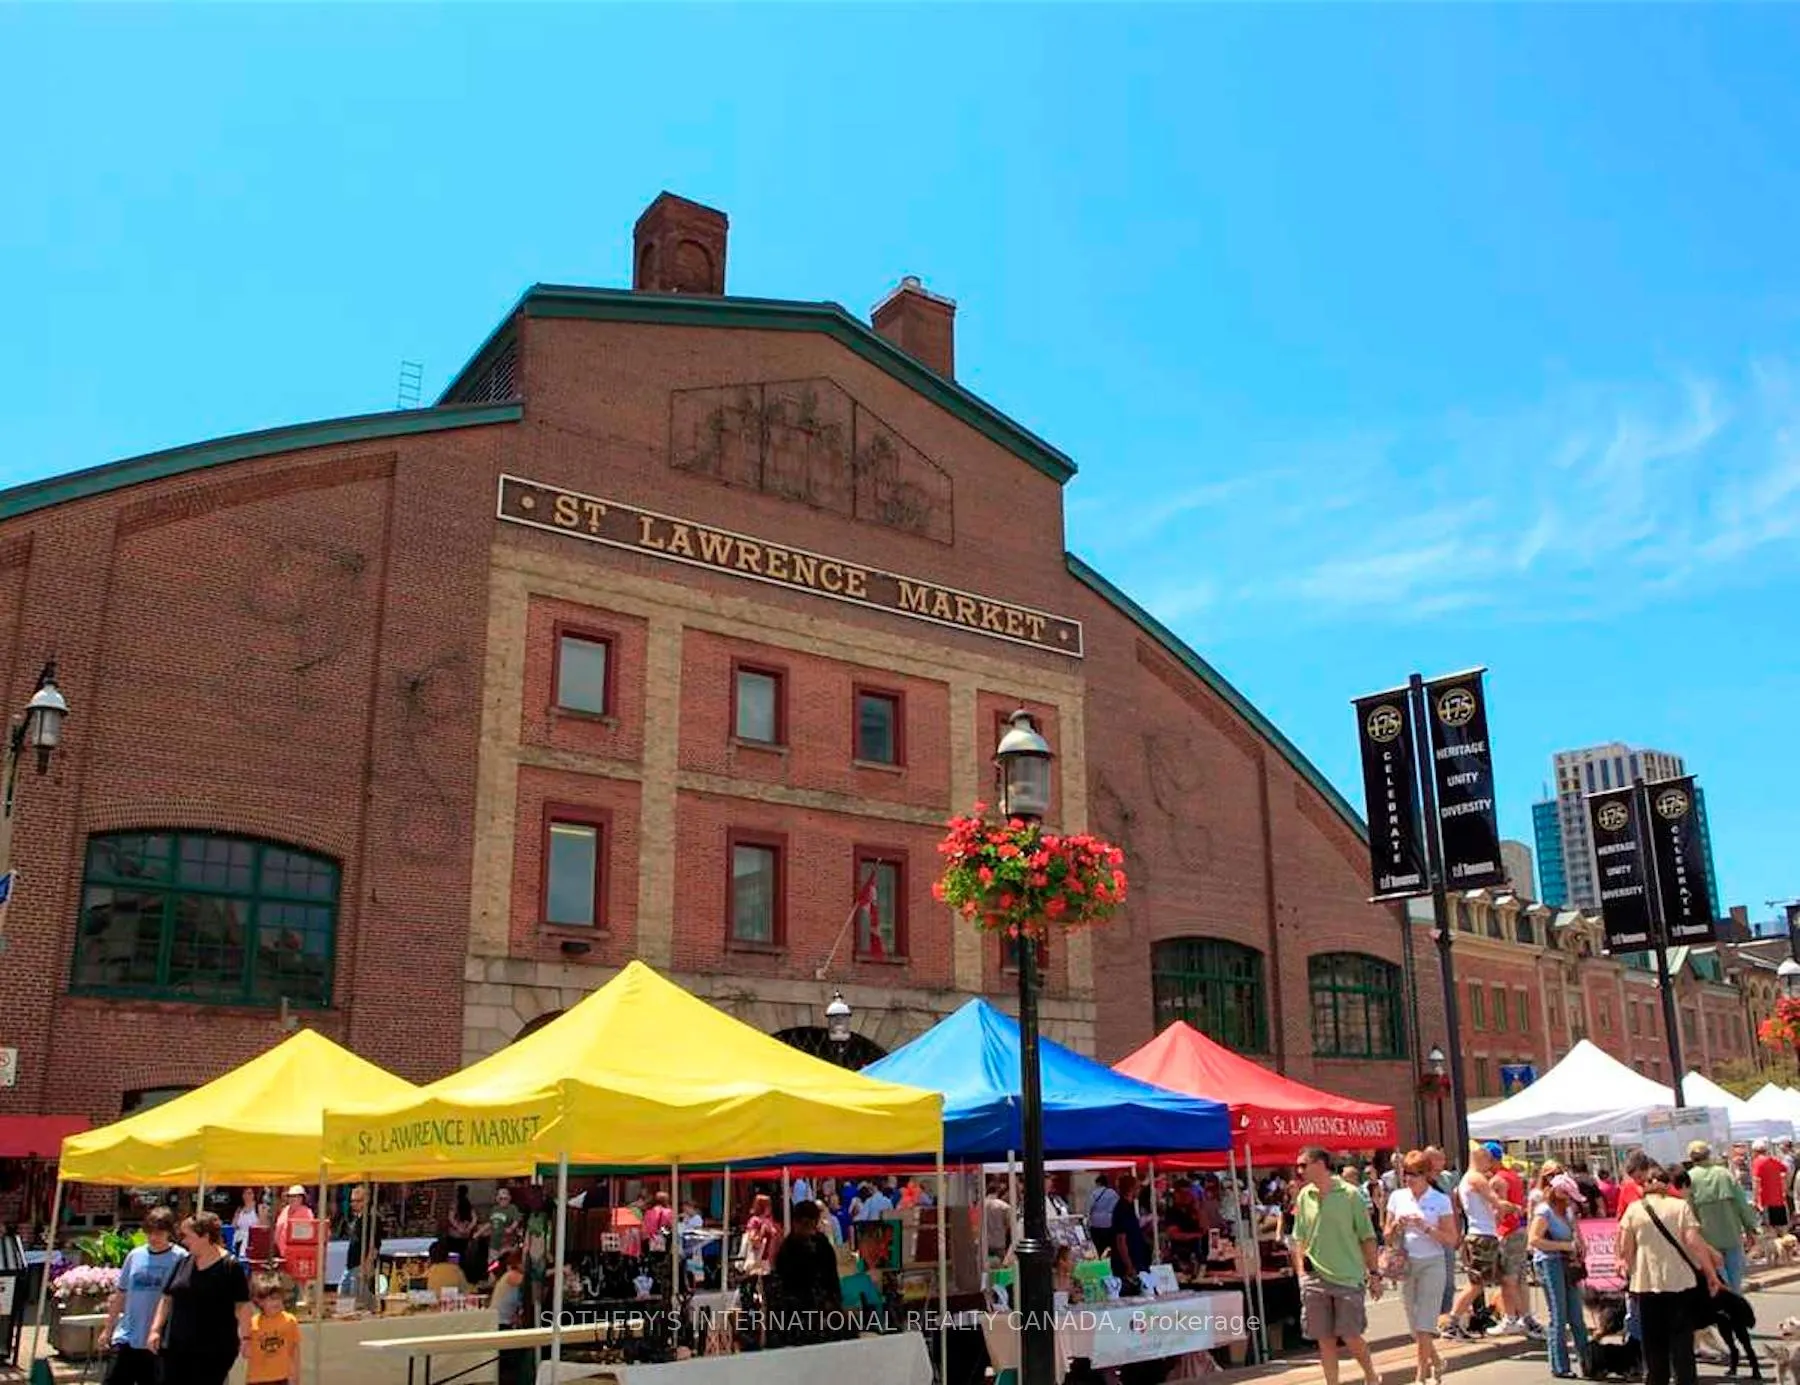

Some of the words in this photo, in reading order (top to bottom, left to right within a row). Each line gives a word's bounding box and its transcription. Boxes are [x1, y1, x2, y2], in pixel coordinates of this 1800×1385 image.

[639, 517, 868, 599] LAWRENCE
[898, 581, 1047, 641] MARKET
[1436, 741, 1486, 760] HERITAGE
[1447, 771, 1479, 787] UNITY
[1383, 752, 1401, 864] CELEBRATE
[1441, 799, 1492, 818] DIVERSITY
[381, 1119, 464, 1153] LAWRENCE
[470, 1115, 541, 1147] MARKET
[1291, 1116, 1347, 1137] LAWRENCE
[1348, 1118, 1388, 1138] MARKET
